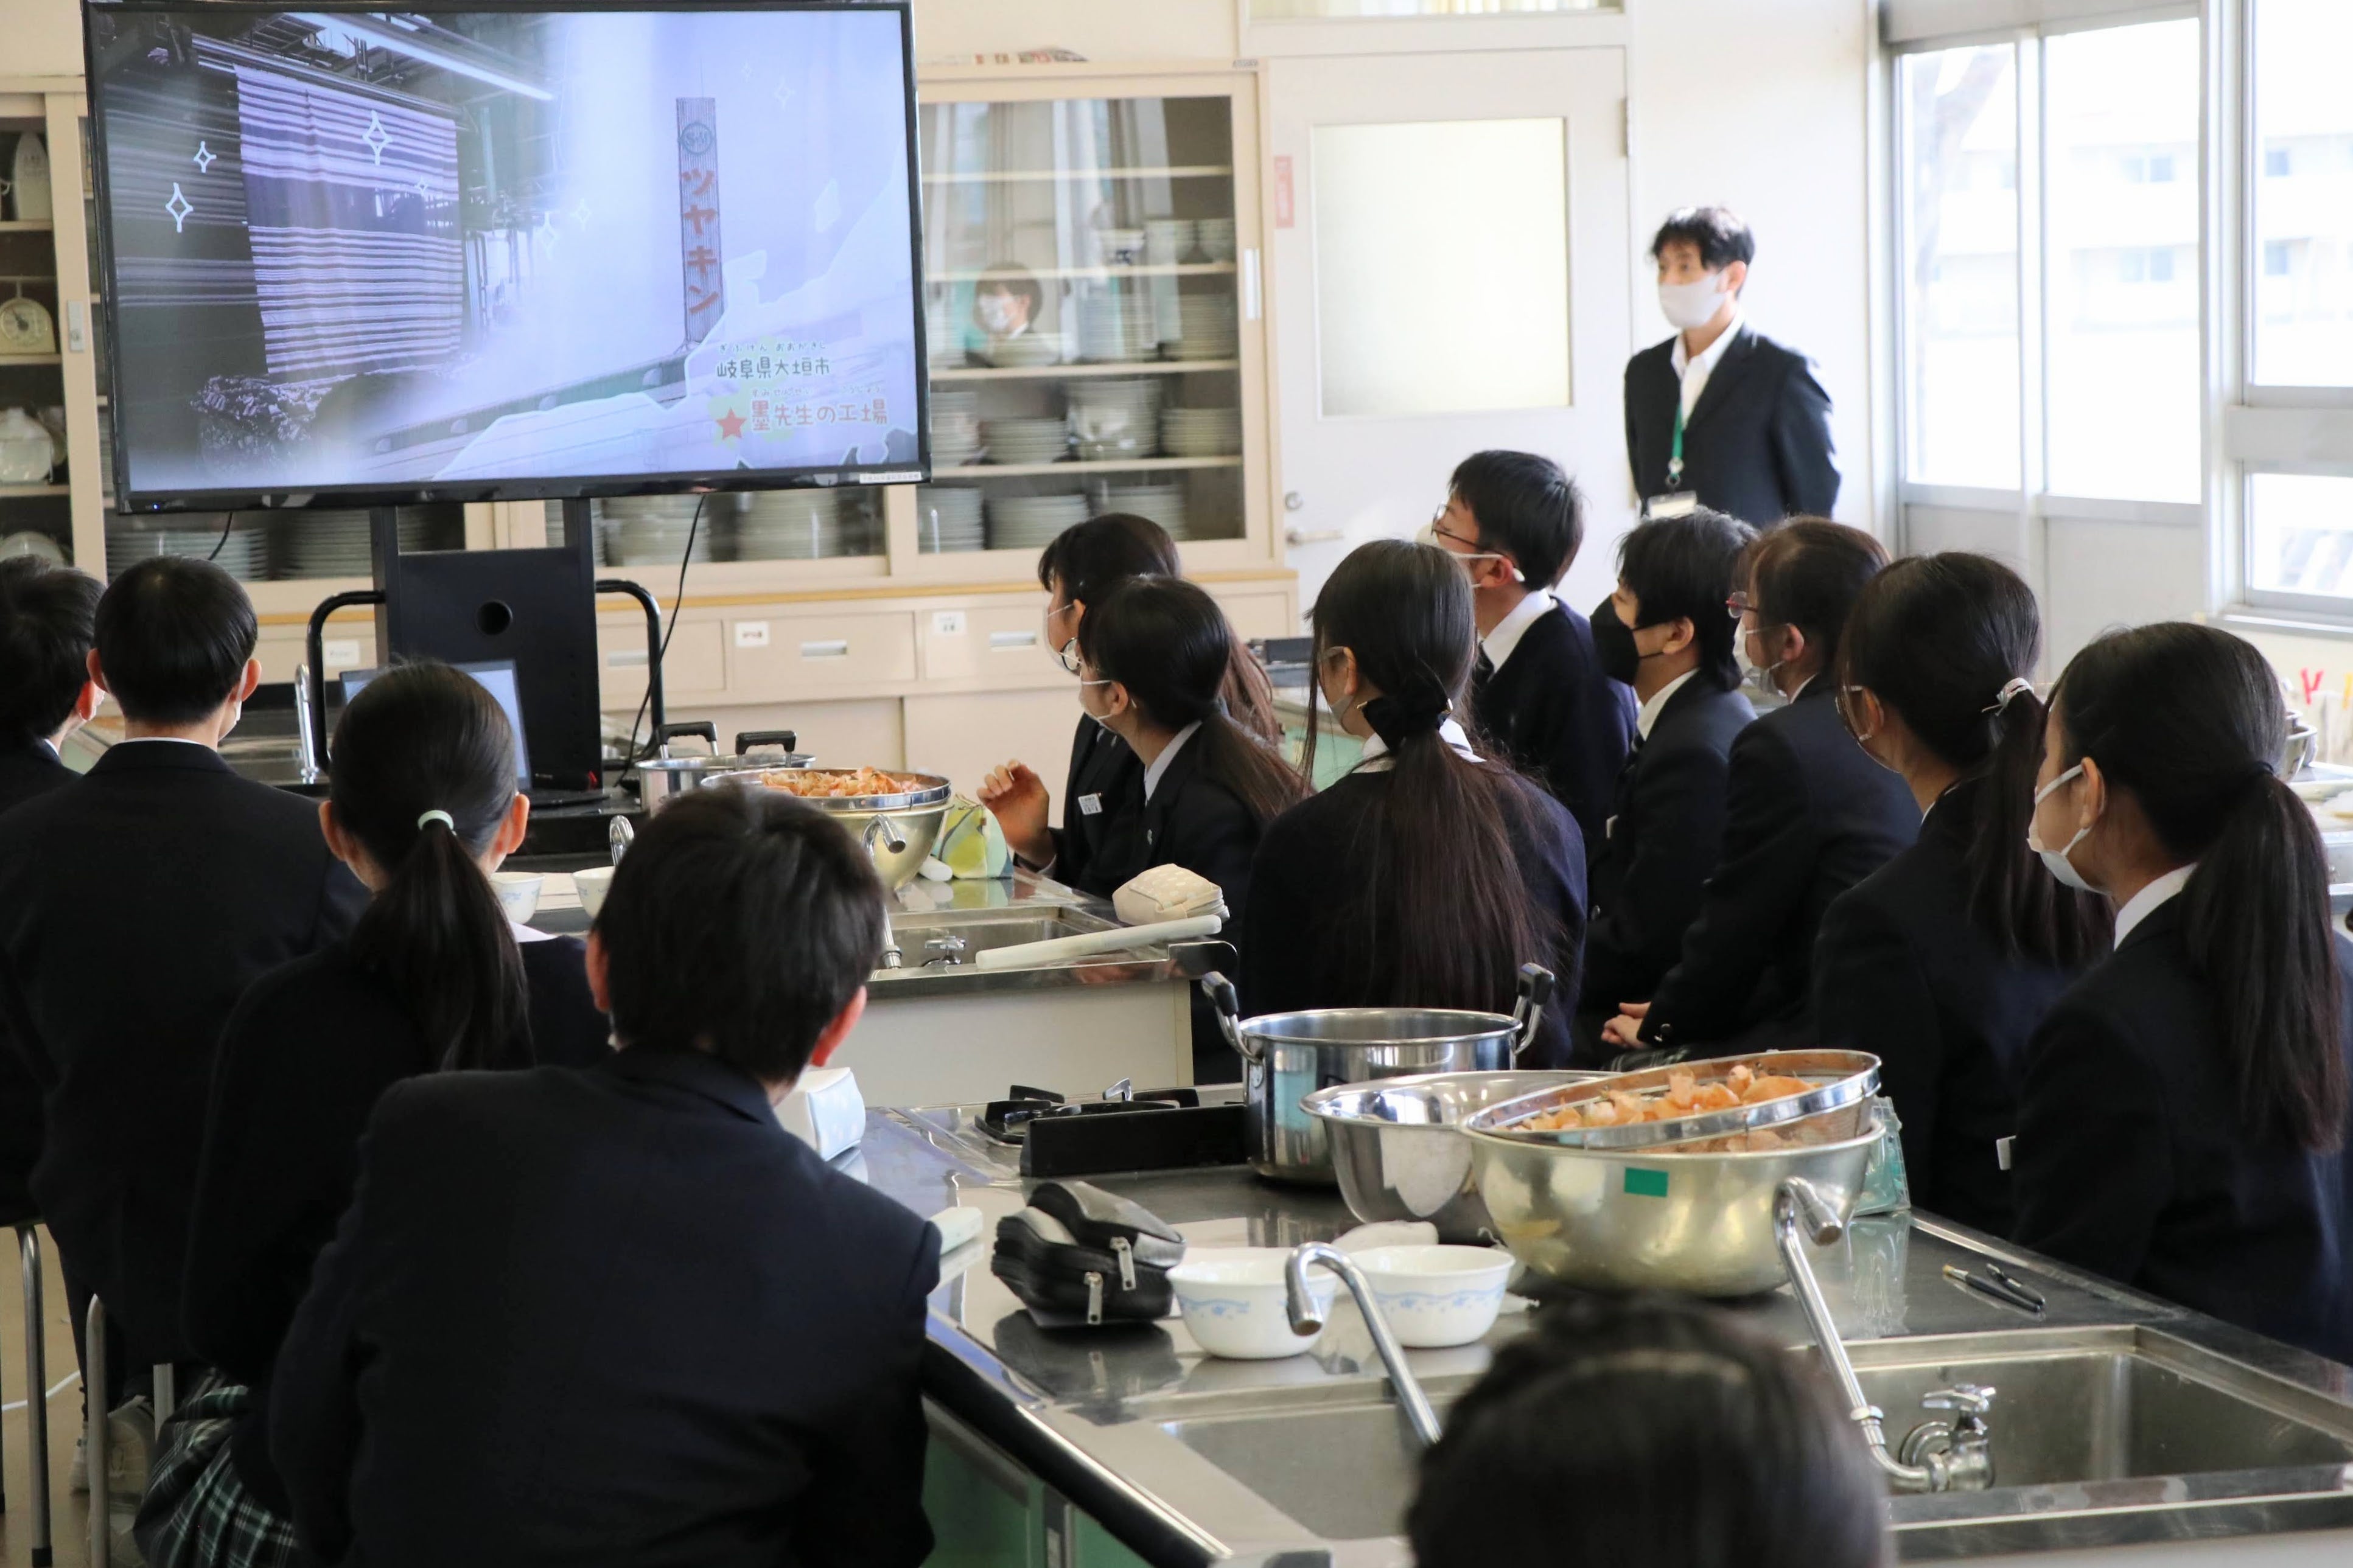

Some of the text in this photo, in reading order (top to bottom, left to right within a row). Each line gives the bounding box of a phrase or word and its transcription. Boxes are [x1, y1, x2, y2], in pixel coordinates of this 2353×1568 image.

[682, 168, 719, 314] ツヤキン
[716, 357, 830, 380] 岐阜県大垣市
[752, 399, 887, 431] 墨先生の工場
